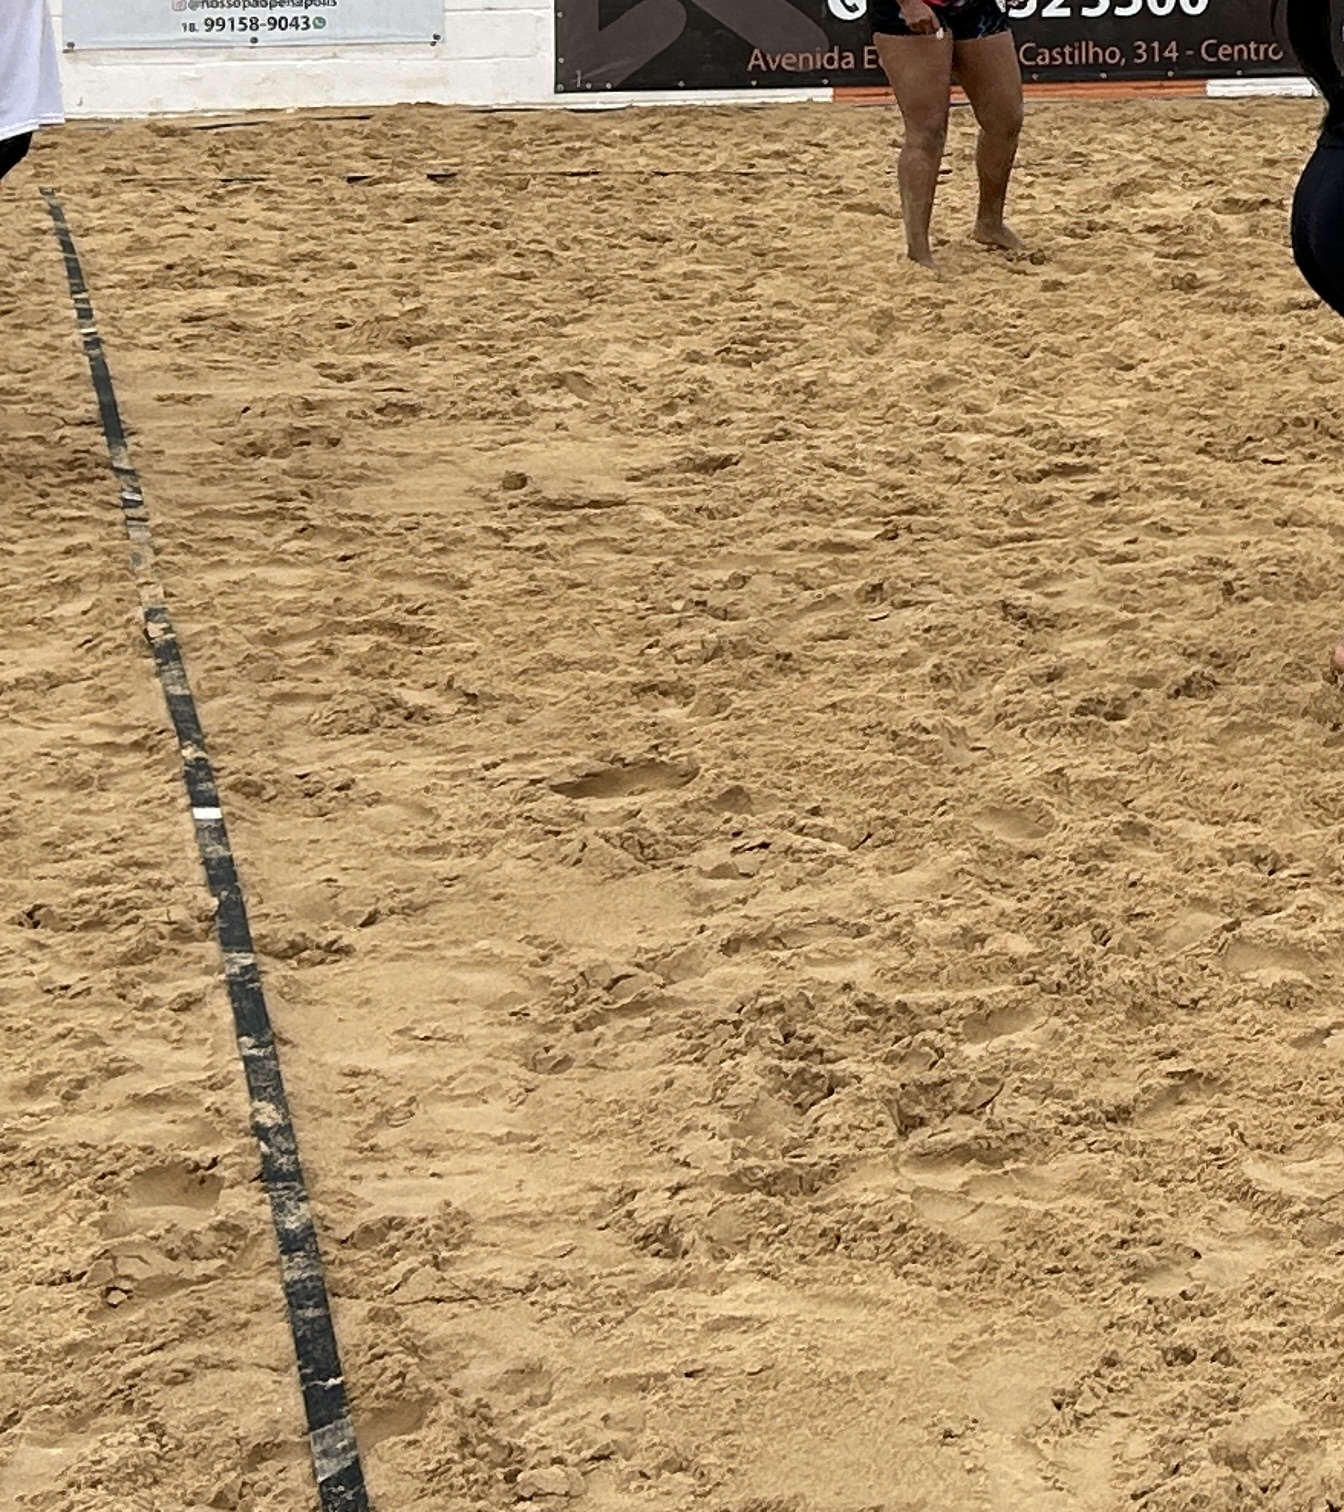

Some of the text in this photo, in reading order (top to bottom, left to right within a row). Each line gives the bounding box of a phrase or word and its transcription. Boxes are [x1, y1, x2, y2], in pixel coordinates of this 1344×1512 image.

[203, 15, 312, 33] 99158-9043
[746, 45, 856, 72] Avenida
[1018, 39, 1126, 67] Castilho,
[1133, 40, 1180, 63] 314
[1200, 39, 1285, 61] Centro
